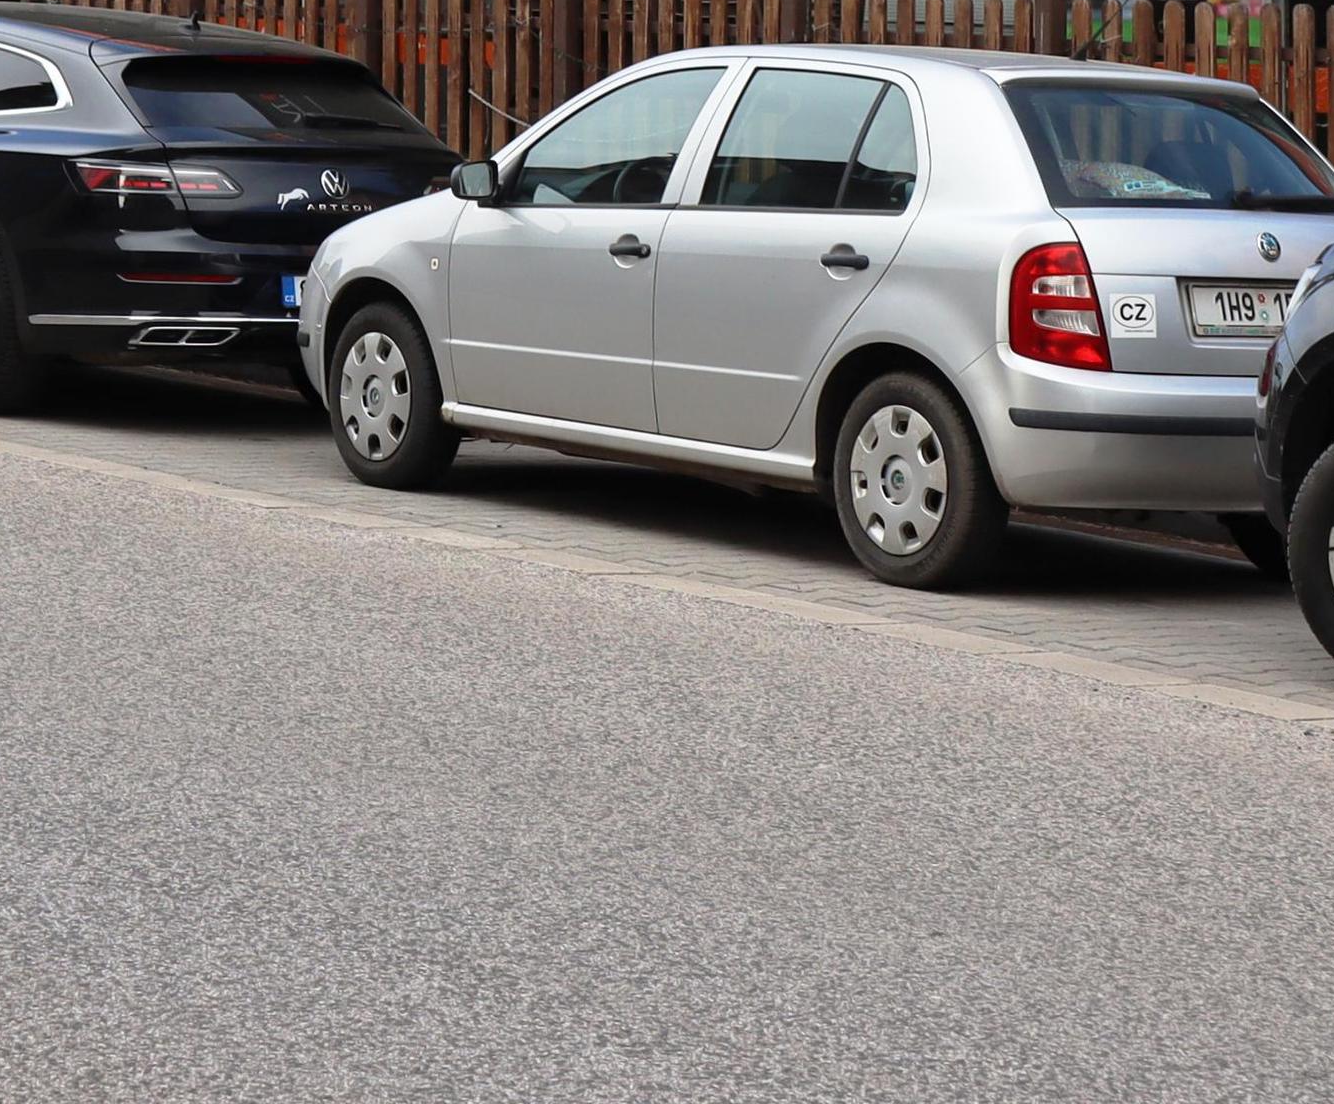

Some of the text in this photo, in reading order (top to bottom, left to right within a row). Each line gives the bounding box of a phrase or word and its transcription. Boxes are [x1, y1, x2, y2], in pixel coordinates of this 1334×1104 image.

[307, 203, 373, 212] ARTEON
[1120, 303, 1147, 321] CZ
[1215, 292, 1256, 322] 1H9
